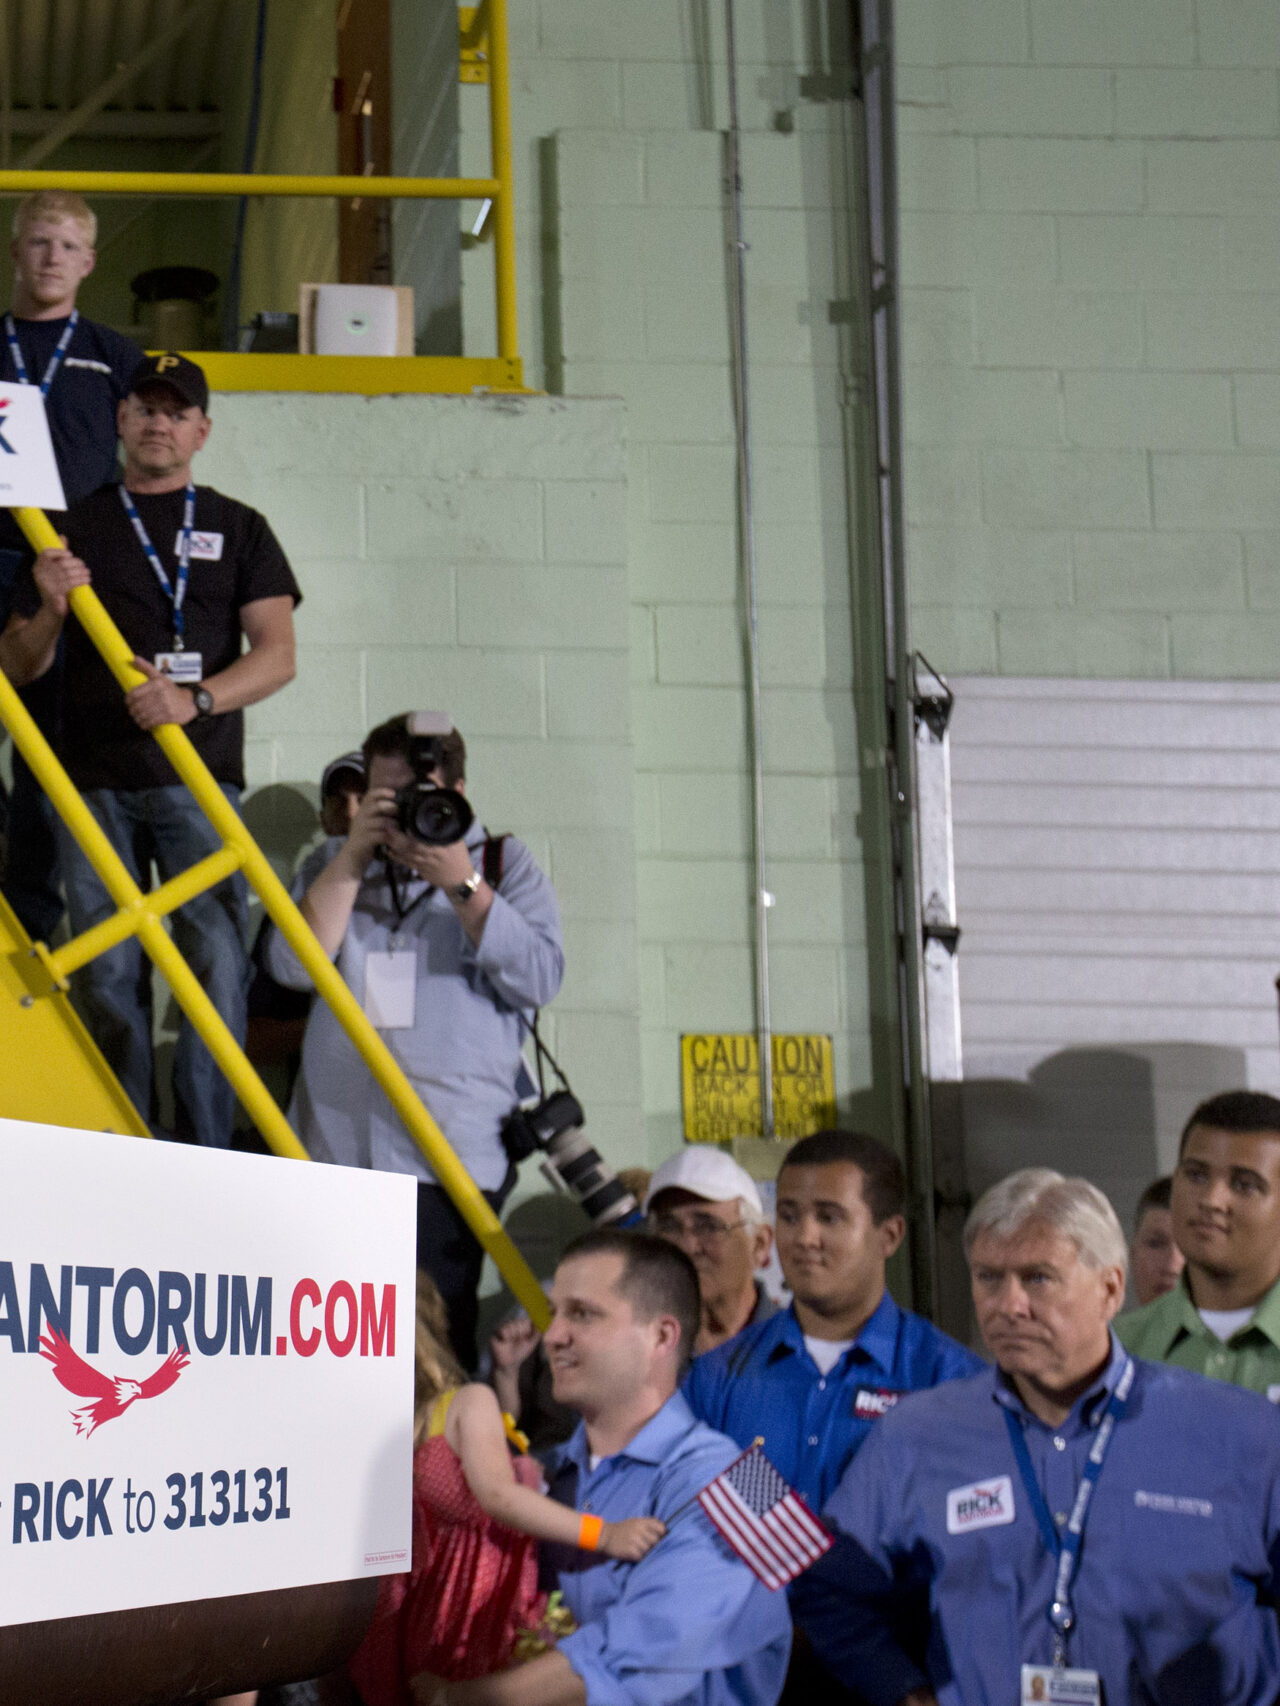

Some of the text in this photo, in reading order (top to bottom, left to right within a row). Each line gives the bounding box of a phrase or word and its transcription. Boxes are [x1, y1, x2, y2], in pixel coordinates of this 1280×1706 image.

[691, 1036, 823, 1074] CAUION
[12, 1477, 114, 1544] RICK
[123, 1478, 156, 1534] to
[163, 1467, 291, 1530] 313131
